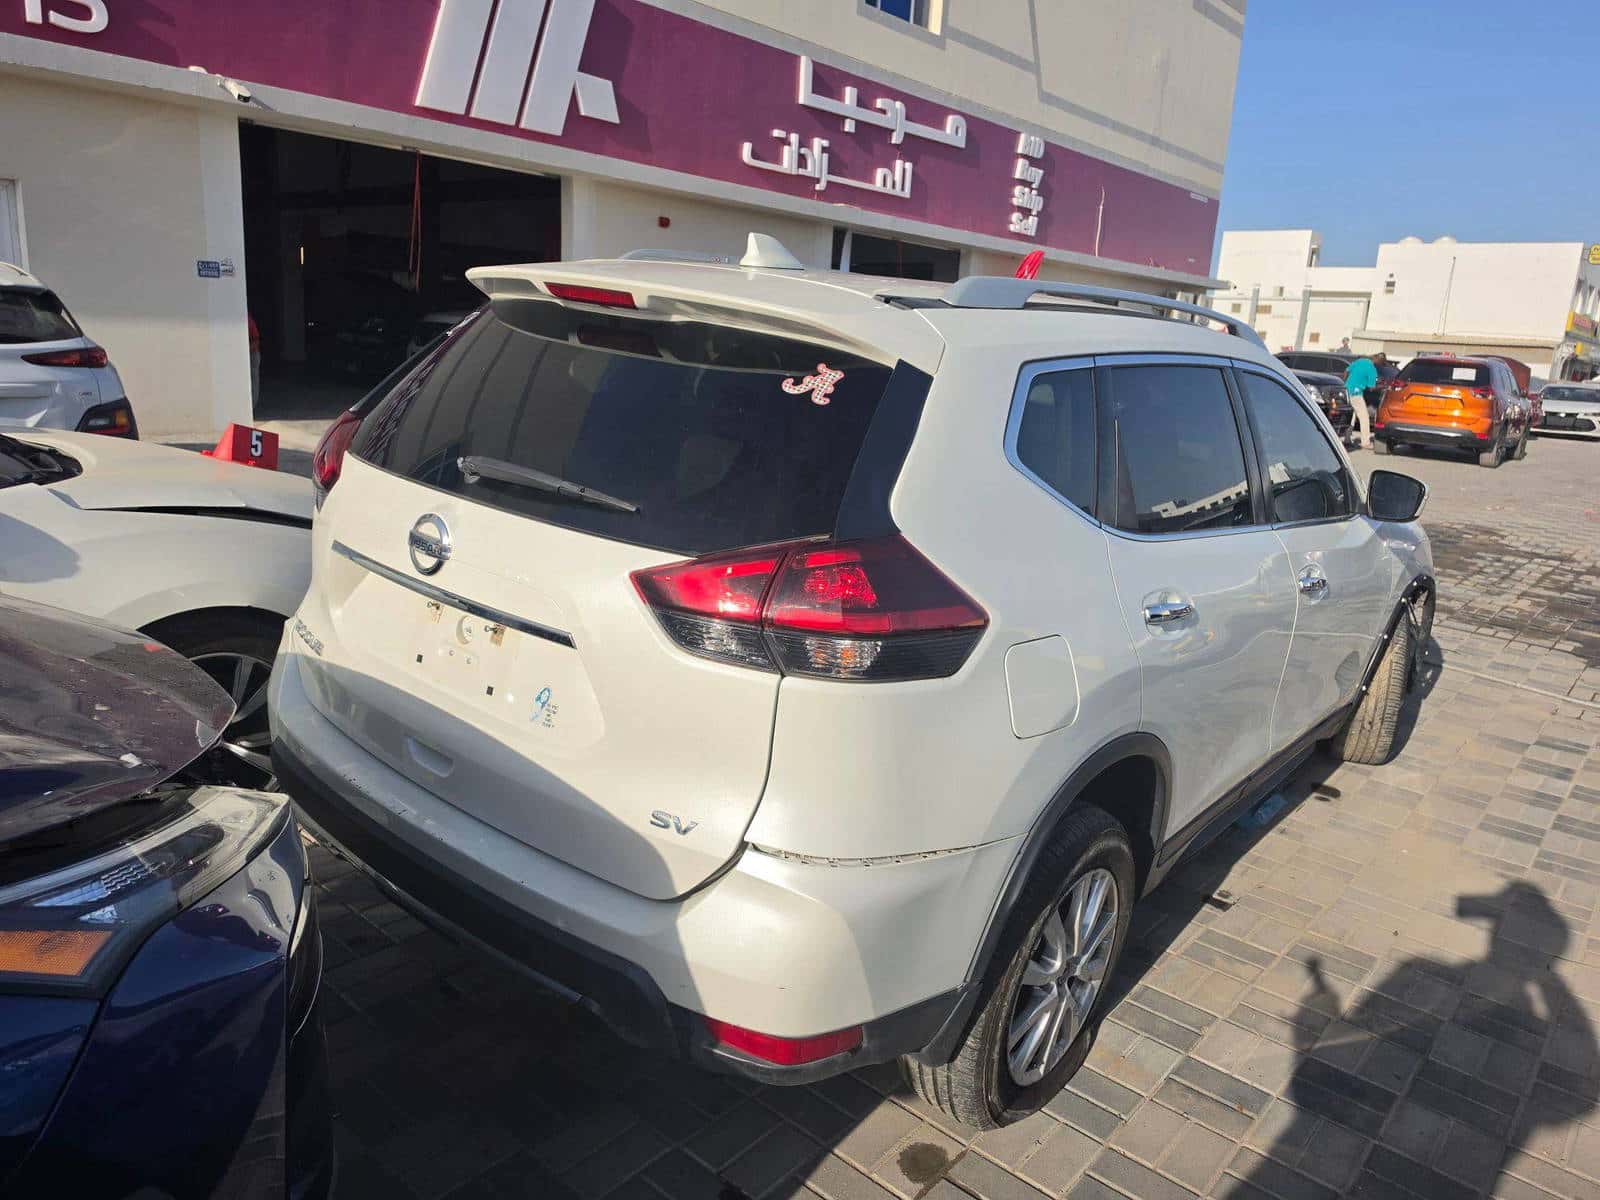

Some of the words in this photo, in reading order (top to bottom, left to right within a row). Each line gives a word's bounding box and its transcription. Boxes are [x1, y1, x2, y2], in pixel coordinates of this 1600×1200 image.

[798, 55, 967, 149] مرحبا
[742, 129, 913, 199] للمزادات
[250, 429, 263, 457] 5
[650, 810, 699, 835] SV
